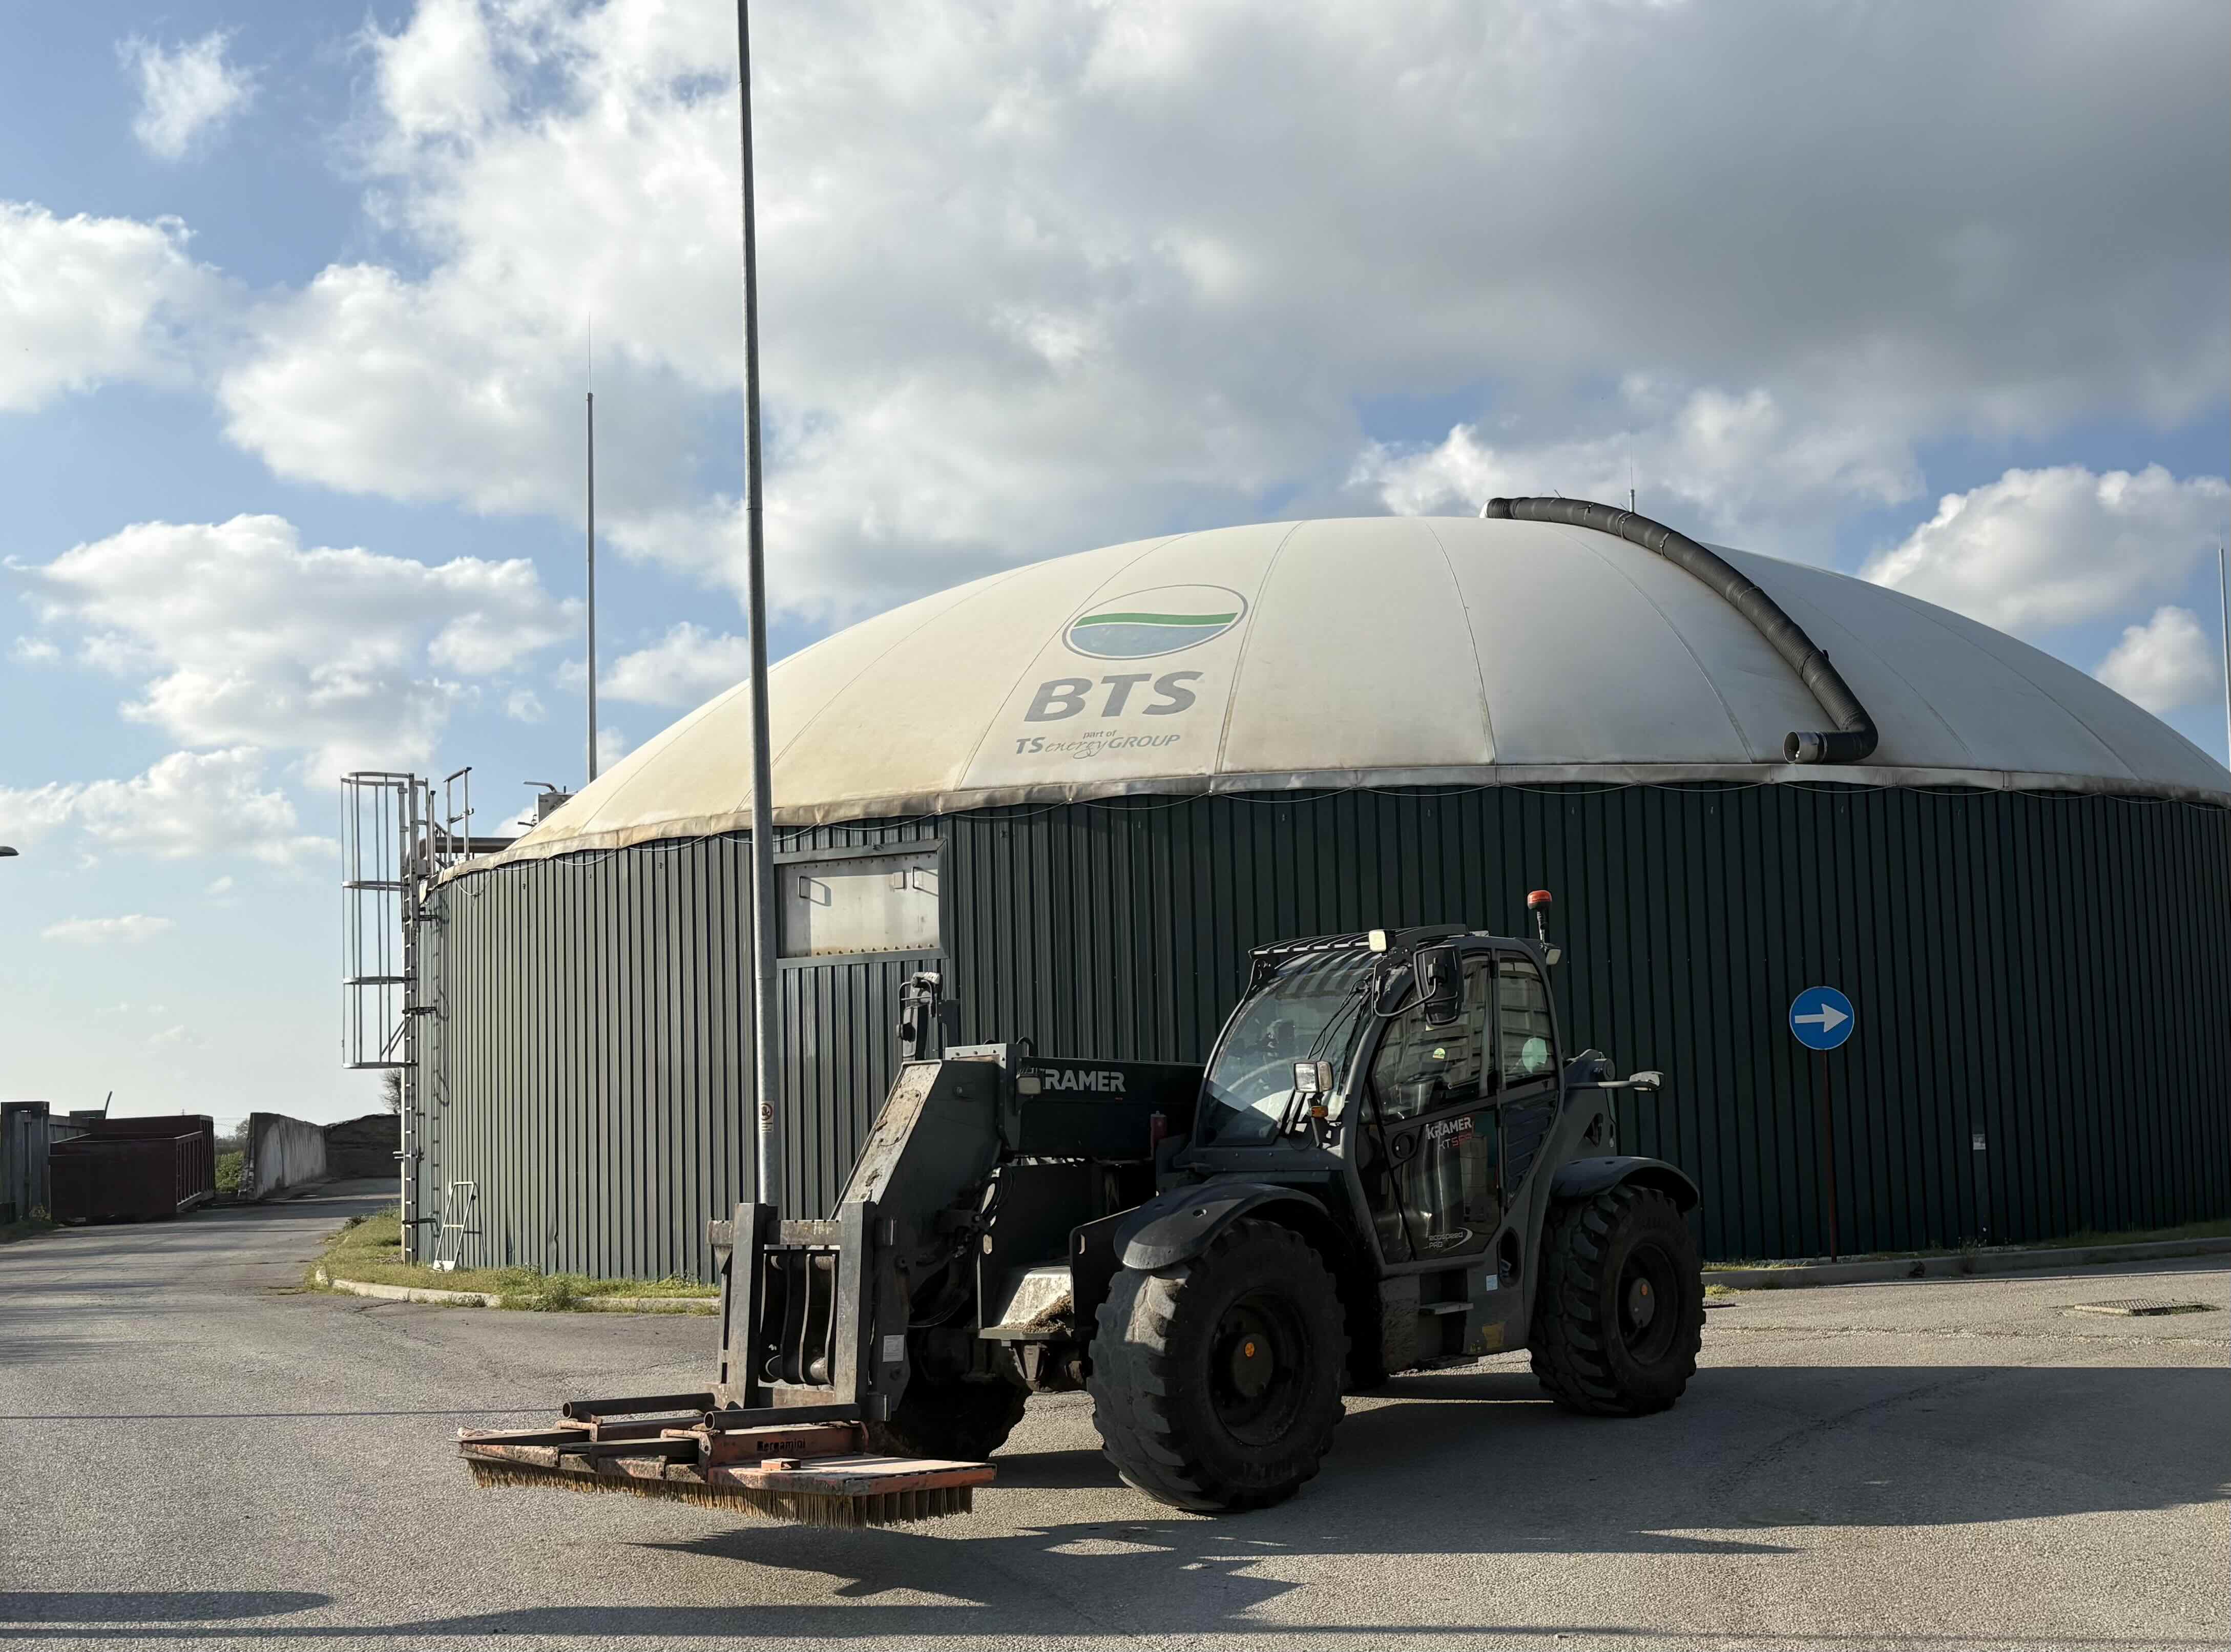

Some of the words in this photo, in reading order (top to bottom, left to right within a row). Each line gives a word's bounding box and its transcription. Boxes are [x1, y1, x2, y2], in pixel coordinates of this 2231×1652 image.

[1024, 671, 1204, 722] BTS
[1039, 1068, 1127, 1092] RAMER
[1426, 1117, 1472, 1140] KRAMER
